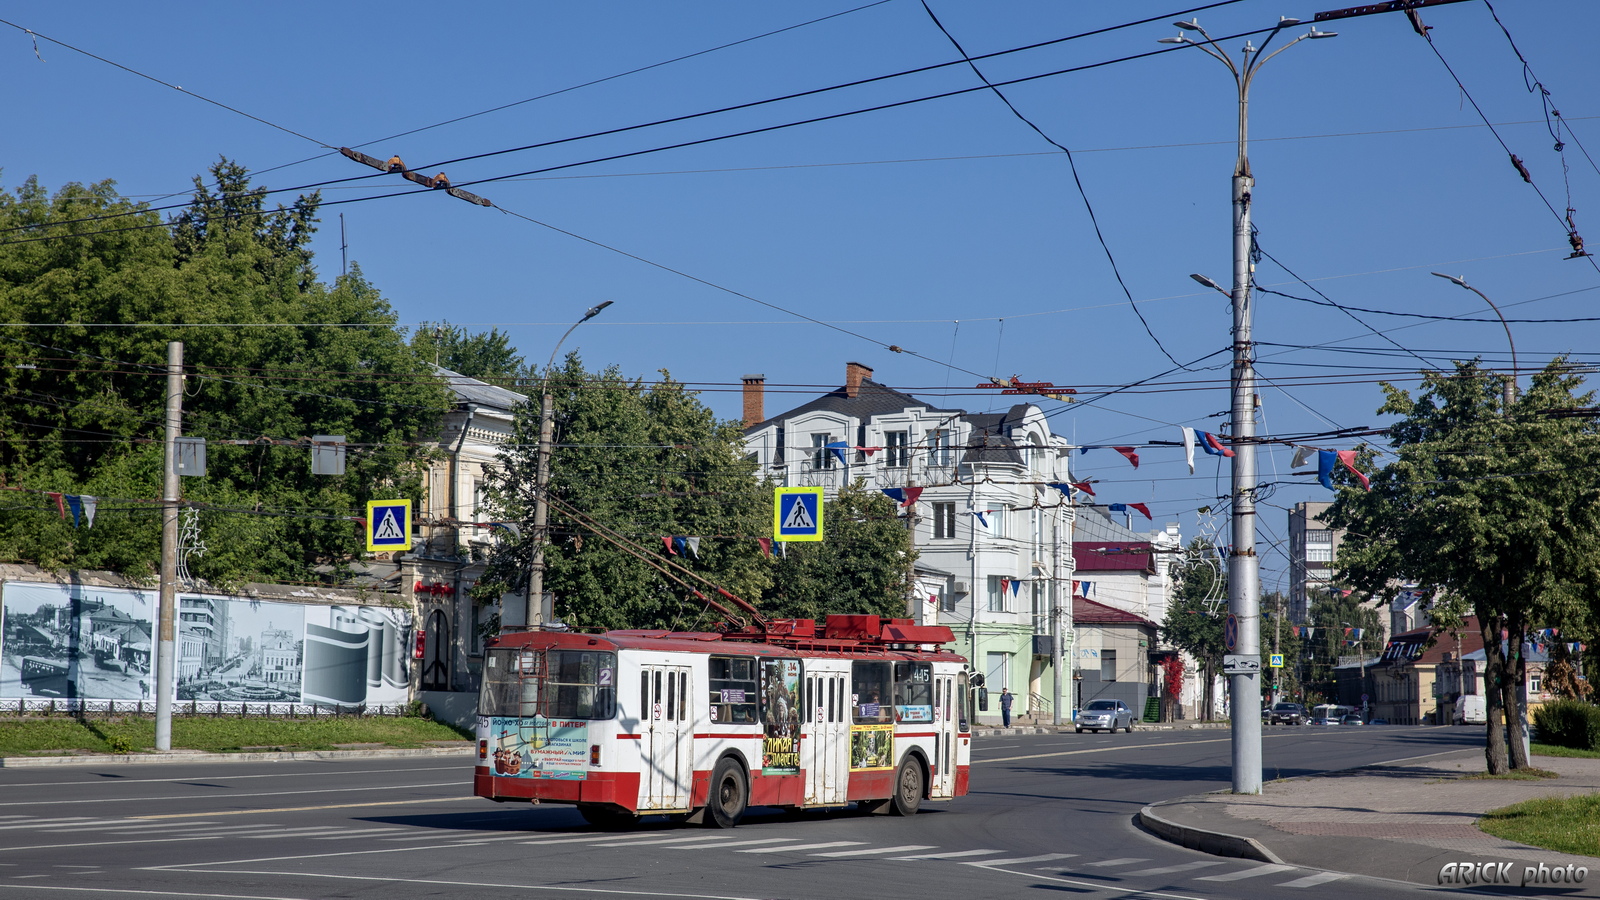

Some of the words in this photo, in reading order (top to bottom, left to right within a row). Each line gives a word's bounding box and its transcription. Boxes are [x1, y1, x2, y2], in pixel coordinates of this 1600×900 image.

[790, 662, 796, 671] 14
[600, 670, 611, 685] 2
[914, 668, 930, 682] 445
[724, 692, 728, 702] 2
[767, 738, 792, 754] ДИКАЯ
